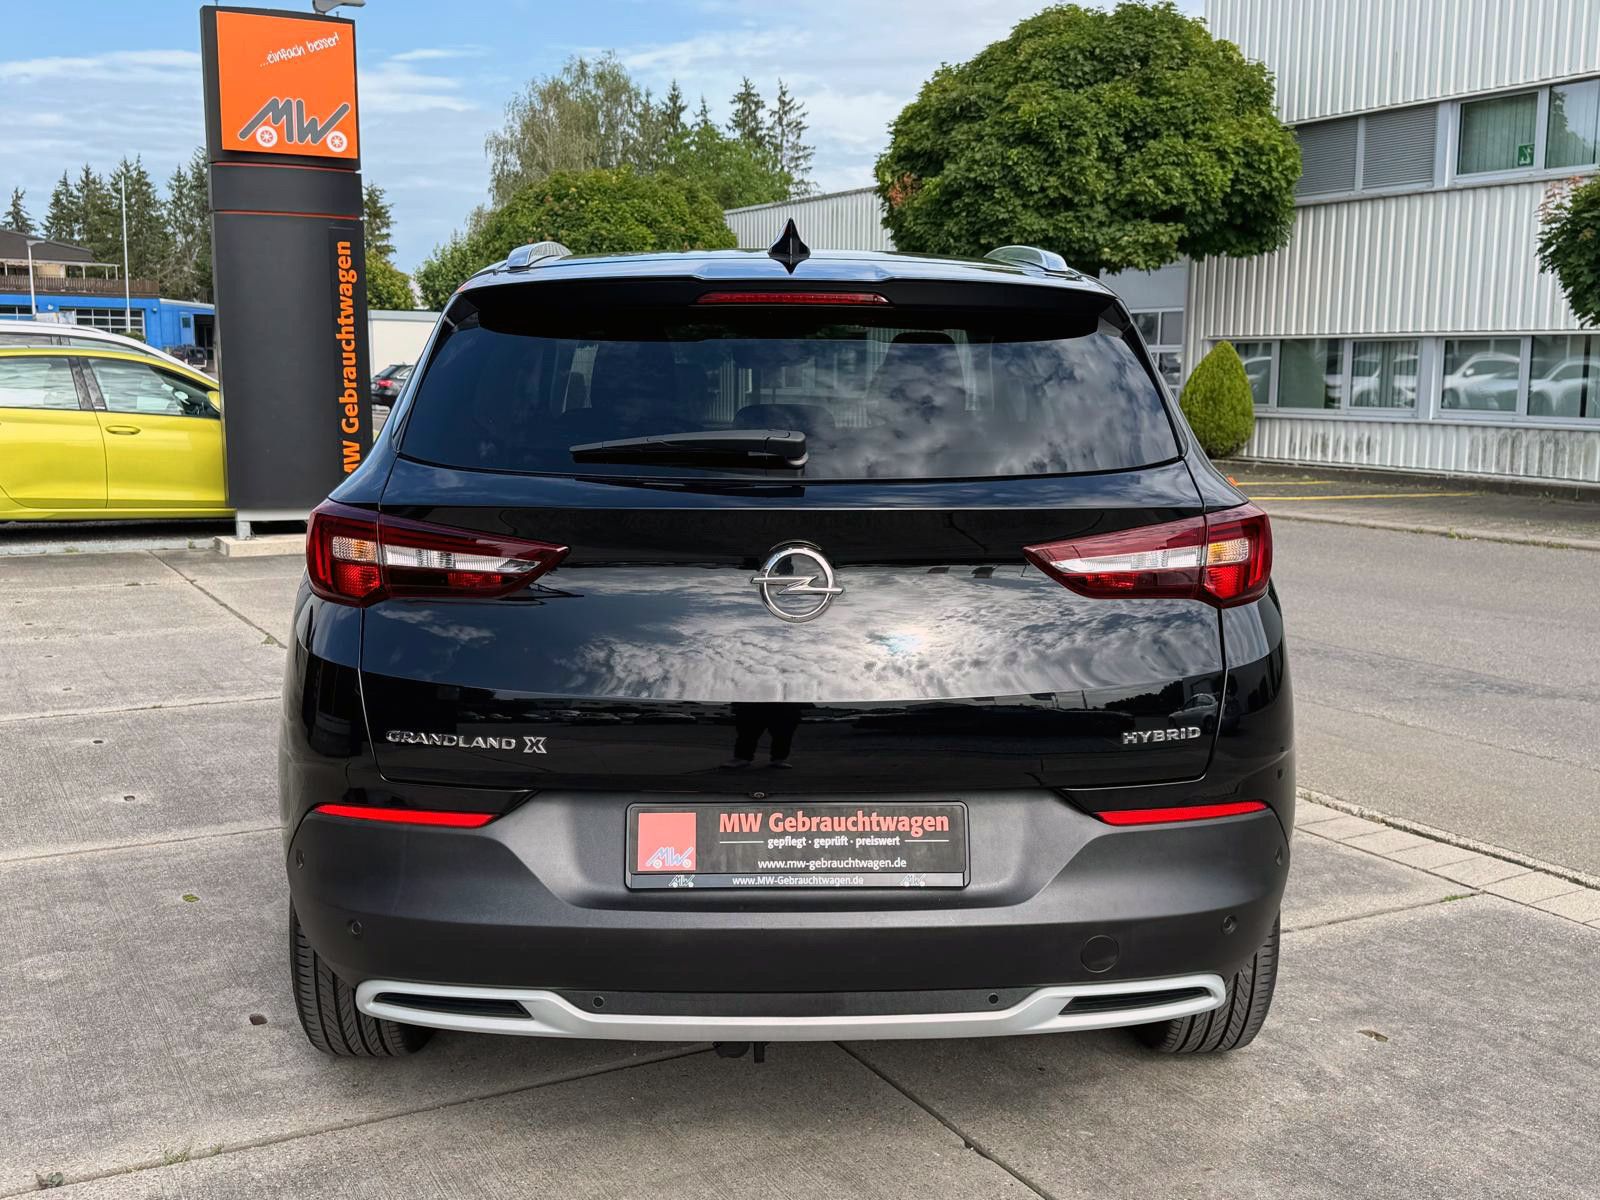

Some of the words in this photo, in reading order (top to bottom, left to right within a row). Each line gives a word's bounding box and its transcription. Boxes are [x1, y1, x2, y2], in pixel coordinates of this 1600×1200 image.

[306, 32, 340, 53] besser!
[238, 96, 351, 145] MW
[336, 240, 360, 434] Gebrauchtwagen
[385, 730, 517, 751] GRANDLAND
[522, 736, 548, 754] X
[1122, 726, 1201, 744] HYBRID
[719, 812, 763, 833] MW
[768, 810, 950, 838] Gebrauchtwagen
[767, 835, 807, 849] gepflegt
[813, 835, 849, 849] geprüft
[855, 834, 901, 848] preiswert
[757, 857, 908, 871] www.mw-gebrauchtwagen.de
[731, 874, 865, 887] www.MW-Gebrauchtwagen.de
